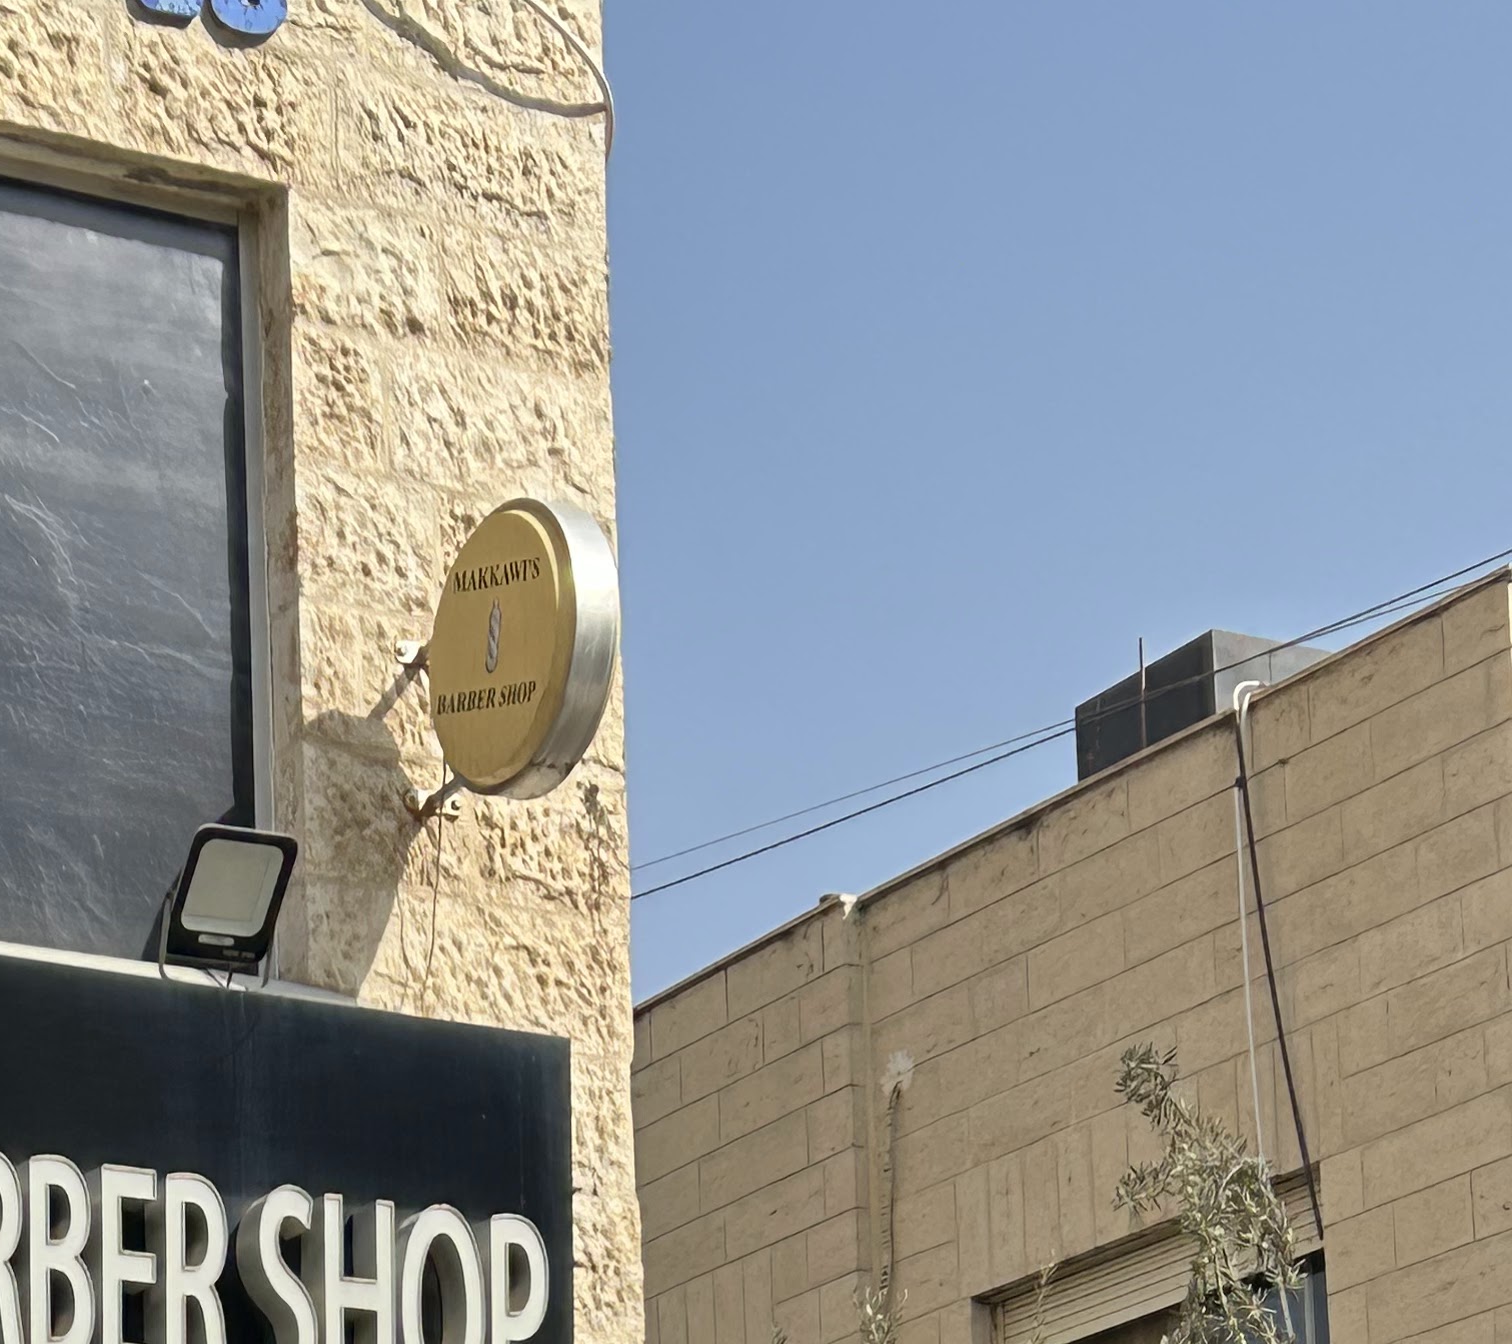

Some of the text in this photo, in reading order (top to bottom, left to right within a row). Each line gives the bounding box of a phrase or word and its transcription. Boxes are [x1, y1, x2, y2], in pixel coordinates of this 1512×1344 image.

[453, 557, 540, 594] MAKKAWI'S
[437, 680, 536, 716] BARBER SHOP
